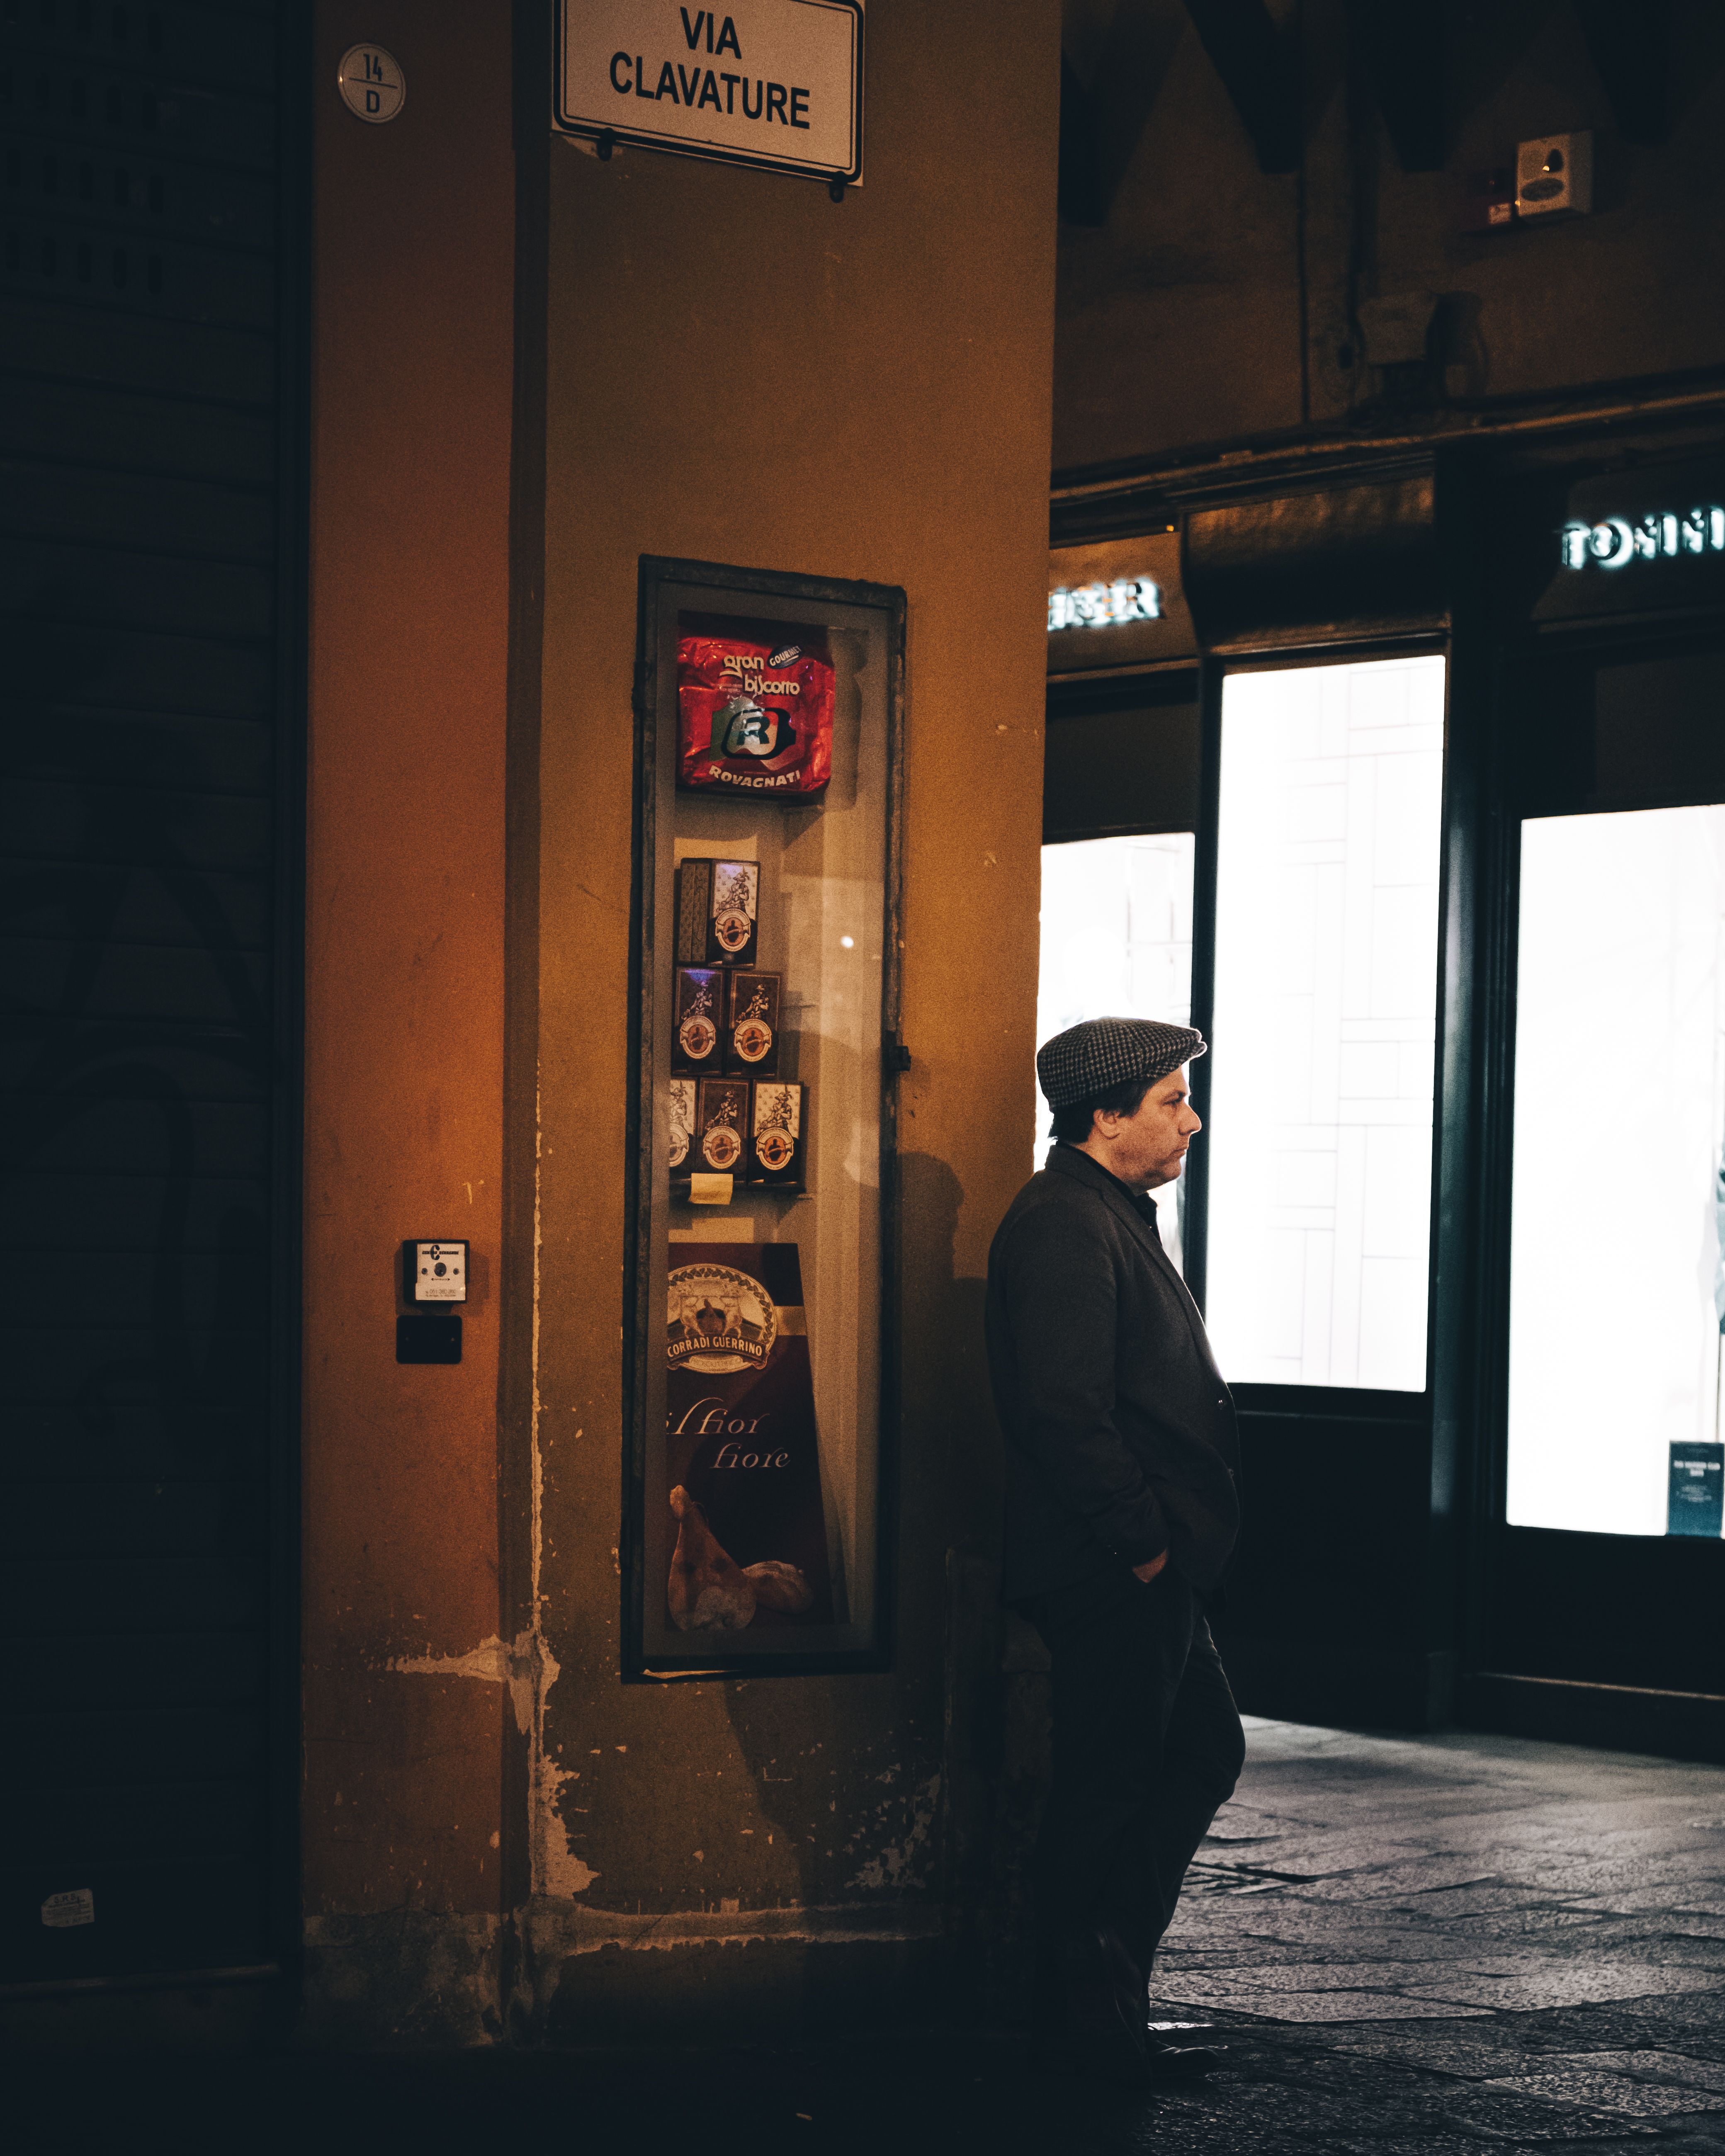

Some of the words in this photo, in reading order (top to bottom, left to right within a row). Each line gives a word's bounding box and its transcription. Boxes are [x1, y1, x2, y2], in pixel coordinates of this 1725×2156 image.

[680, 7, 742, 59] VIA
[363, 53, 382, 82] 14
[366, 90, 380, 113] D
[610, 51, 810, 129] CLAVATURE
[719, 655, 764, 679] gran
[770, 646, 802, 666] GOURMET
[709, 765, 801, 787] ROVAGNATI
[667, 1337, 710, 1357] CORRADI
[713, 1336, 763, 1357] GUERRINO
[693, 1408, 770, 1434] fior
[705, 1442, 791, 1469] fiore
